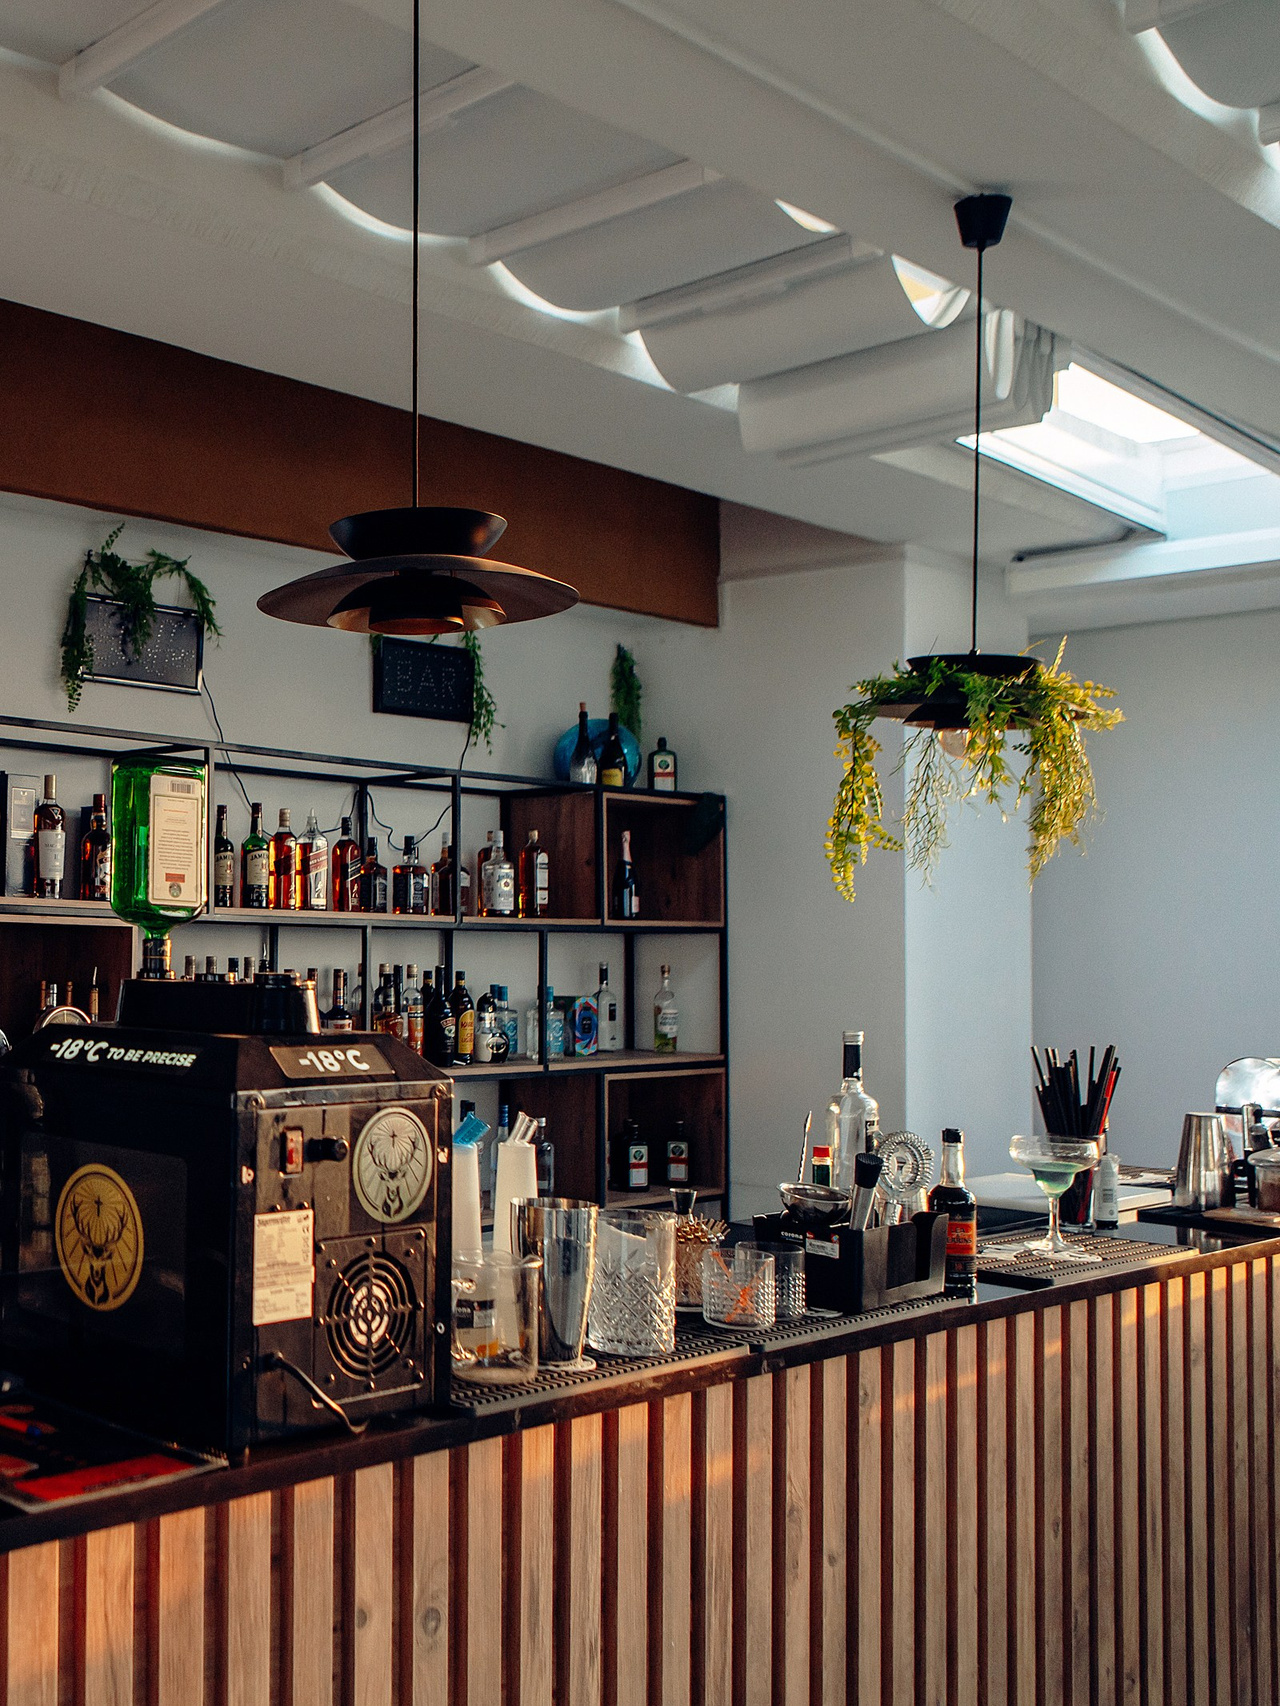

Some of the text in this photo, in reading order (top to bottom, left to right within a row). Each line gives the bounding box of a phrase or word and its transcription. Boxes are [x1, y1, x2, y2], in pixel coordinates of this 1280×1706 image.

[397, 660, 455, 699] BAR
[50, 1038, 196, 1067] -18°C TO BE PRECISE
[299, 1049, 370, 1072] -18°C
[781, 1231, 803, 1239] corona
